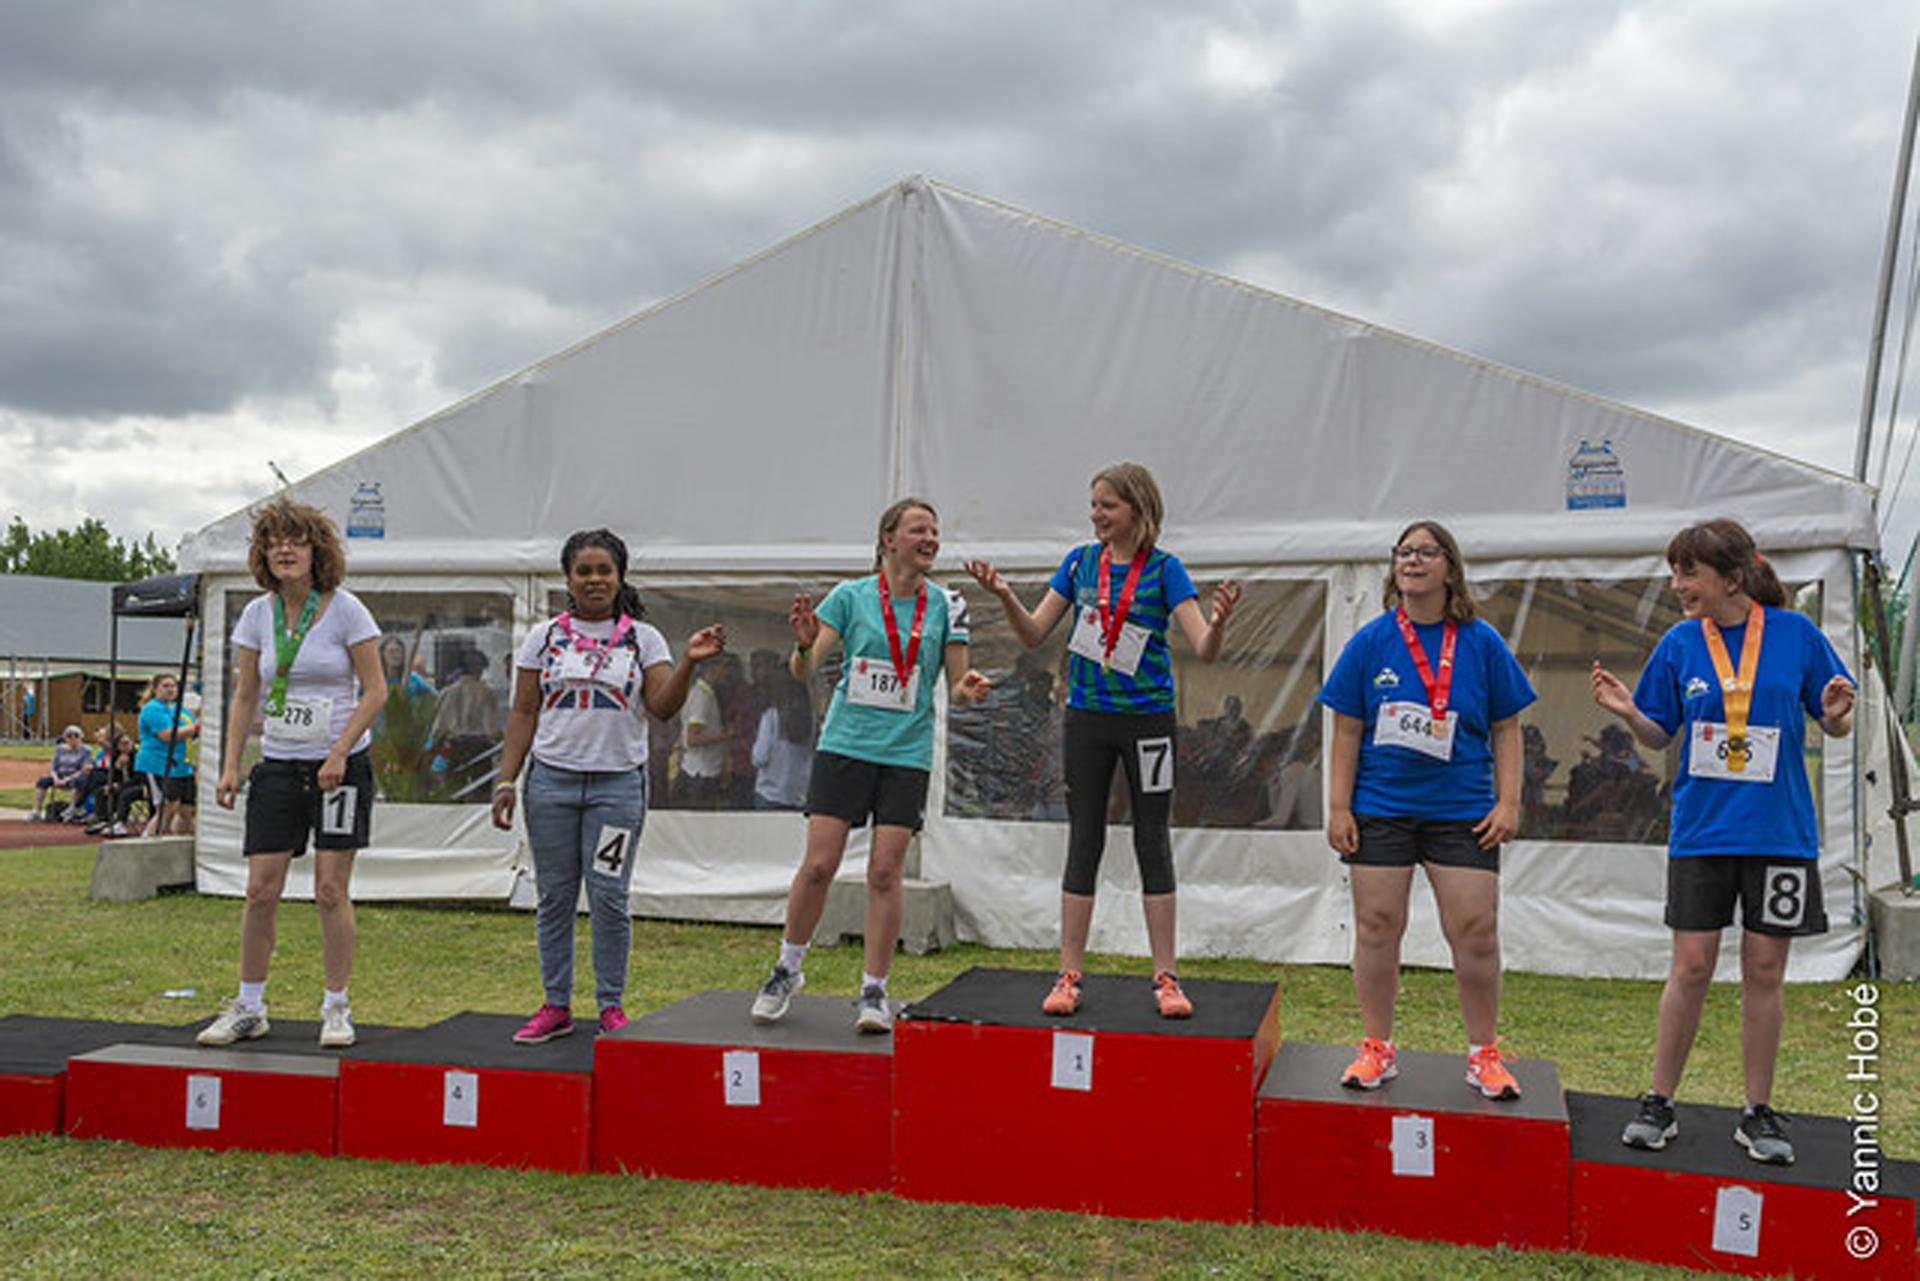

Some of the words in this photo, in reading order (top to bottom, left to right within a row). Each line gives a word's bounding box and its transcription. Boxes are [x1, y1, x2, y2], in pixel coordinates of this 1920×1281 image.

[871, 673, 898, 692] 187
[284, 707, 313, 726] 278
[1717, 740, 1753, 763] 65
[1143, 743, 1168, 786] 7
[329, 791, 347, 828] 1
[597, 833, 625, 871] 4
[1768, 873, 1800, 920] 8
[1075, 1054, 1083, 1071] 1
[732, 1070, 743, 1087] 2
[195, 1092, 207, 1108] 6
[452, 1085, 463, 1099] 4
[1416, 1130, 1428, 1149] 3
[1738, 1212, 1751, 1231] 5
